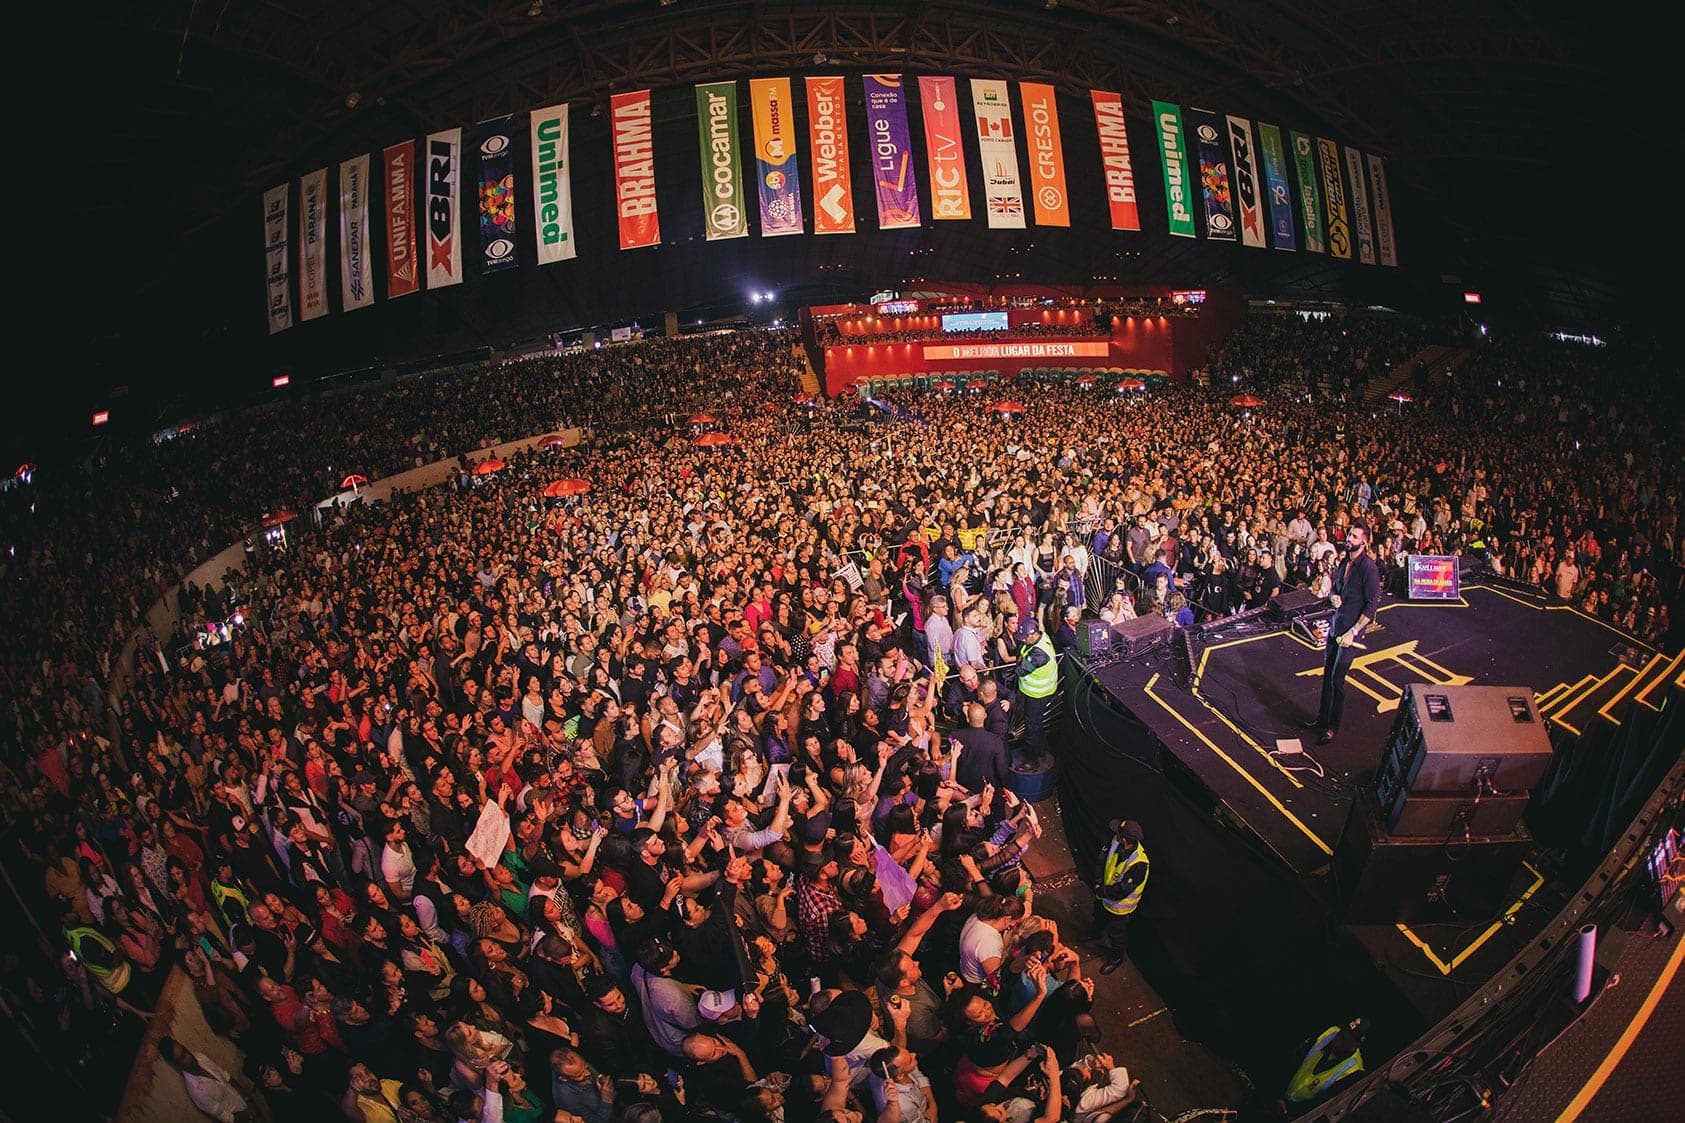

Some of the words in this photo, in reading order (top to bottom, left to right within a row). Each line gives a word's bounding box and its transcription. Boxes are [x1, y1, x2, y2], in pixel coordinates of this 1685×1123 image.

[537, 118, 568, 245] Unimed
[615, 100, 657, 217] BRAHMA
[708, 92, 734, 198] cocamar
[814, 92, 837, 183] Webber
[874, 119, 896, 171] Ligue
[1032, 98, 1055, 179] CRESOL
[1096, 101, 1136, 203] BRAHMA
[1158, 112, 1190, 222] Unimed
[351, 221, 361, 278] SANEPAR
[391, 152, 406, 262] UNIFAMMA
[953, 347, 960, 357] O
[1001, 346, 1031, 357] LUGAR
[1032, 346, 1045, 356] DA
[1046, 345, 1075, 356] FESTA
